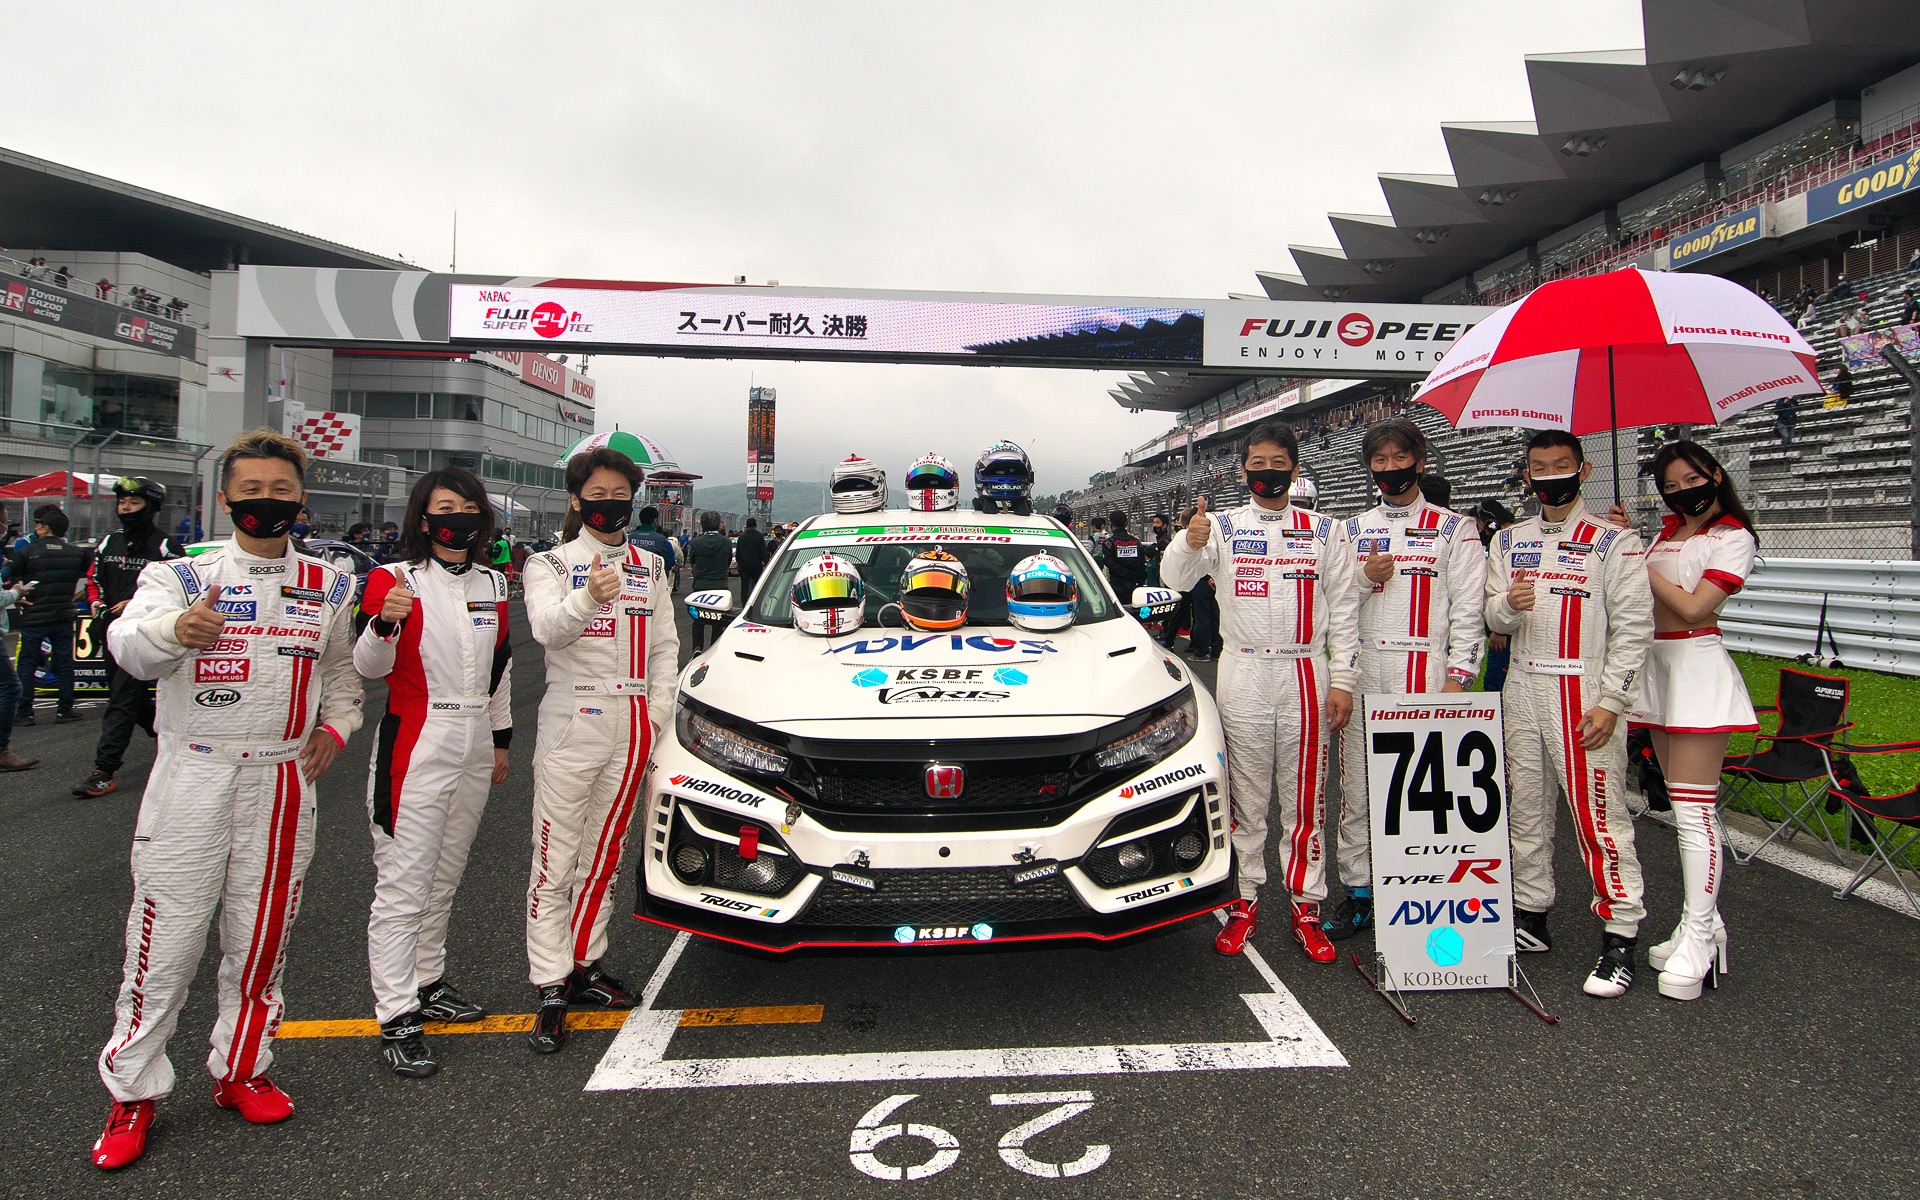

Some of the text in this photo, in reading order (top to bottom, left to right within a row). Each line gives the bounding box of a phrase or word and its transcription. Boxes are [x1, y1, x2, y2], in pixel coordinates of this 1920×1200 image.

[1673, 216, 1757, 260] GOODYEAR
[29, 287, 68, 305] TOYOTA
[478, 290, 511, 303] NAPAC
[27, 297, 64, 312] GAZOO
[26, 304, 61, 322] Racing
[485, 307, 530, 320] FUJI
[149, 321, 178, 335] TOYOTA
[482, 320, 527, 331] SUPER
[569, 323, 593, 333] TEC
[677, 311, 868, 337] スーパー耐久 決勝
[1239, 318, 1476, 342] FUJI SPEE
[116, 322, 145, 342] GR
[146, 328, 175, 342] GAZOO
[1674, 325, 1791, 344] Honda Racing
[145, 335, 174, 350] Racing
[1240, 346, 1338, 360] ENJOY!
[531, 359, 559, 385] DENSO
[571, 378, 594, 400] DENSO
[1280, 393, 1298, 406] HONDA
[1234, 528, 1266, 537] ADVICS
[1362, 527, 1390, 535] ADVICS
[855, 534, 1012, 544] Honda Racing
[1235, 541, 1265, 549] ENDLESS
[1513, 540, 1544, 549] ADVICS
[606, 551, 626, 559] sparco
[1232, 556, 1318, 567] Honda Racing
[1393, 554, 1438, 565] Racing
[1514, 554, 1541, 562] ENDLESS
[249, 565, 286, 575] sparco
[542, 553, 566, 576] sparco
[809, 571, 850, 581] HONDA
[1236, 567, 1264, 577] BBS
[1541, 571, 1588, 584] Racing
[176, 564, 198, 594] sparco
[330, 574, 349, 605] sparco
[1237, 581, 1266, 592] NGK
[620, 594, 648, 604] Racing
[212, 602, 254, 614] NDLESS
[296, 606, 320, 614] Super
[1151, 602, 1177, 615] KSBF
[698, 610, 723, 621] KSBF
[221, 625, 321, 642] nda Racing
[821, 634, 1059, 656] ADVICS
[199, 659, 246, 675] NGK
[895, 668, 983, 681] KSBF
[201, 690, 236, 703] Arai
[1370, 708, 1496, 721] Honda Racing
[1622, 709, 1644, 719] acing
[1372, 730, 1502, 836] 743
[1594, 768, 1628, 899] Racing Honda
[540, 818, 551, 871] Honda
[1404, 844, 1477, 855] CIVIC
[1700, 806, 1717, 895] Honda Racing
[1381, 858, 1502, 885] TYPE R
[1115, 881, 1175, 904] TRUST
[699, 892, 763, 913] TRUST
[1388, 897, 1501, 926] ADVICS
[918, 926, 969, 939] KSBF
[134, 896, 157, 988] Honda
[1403, 971, 1489, 987] KOBOtect
